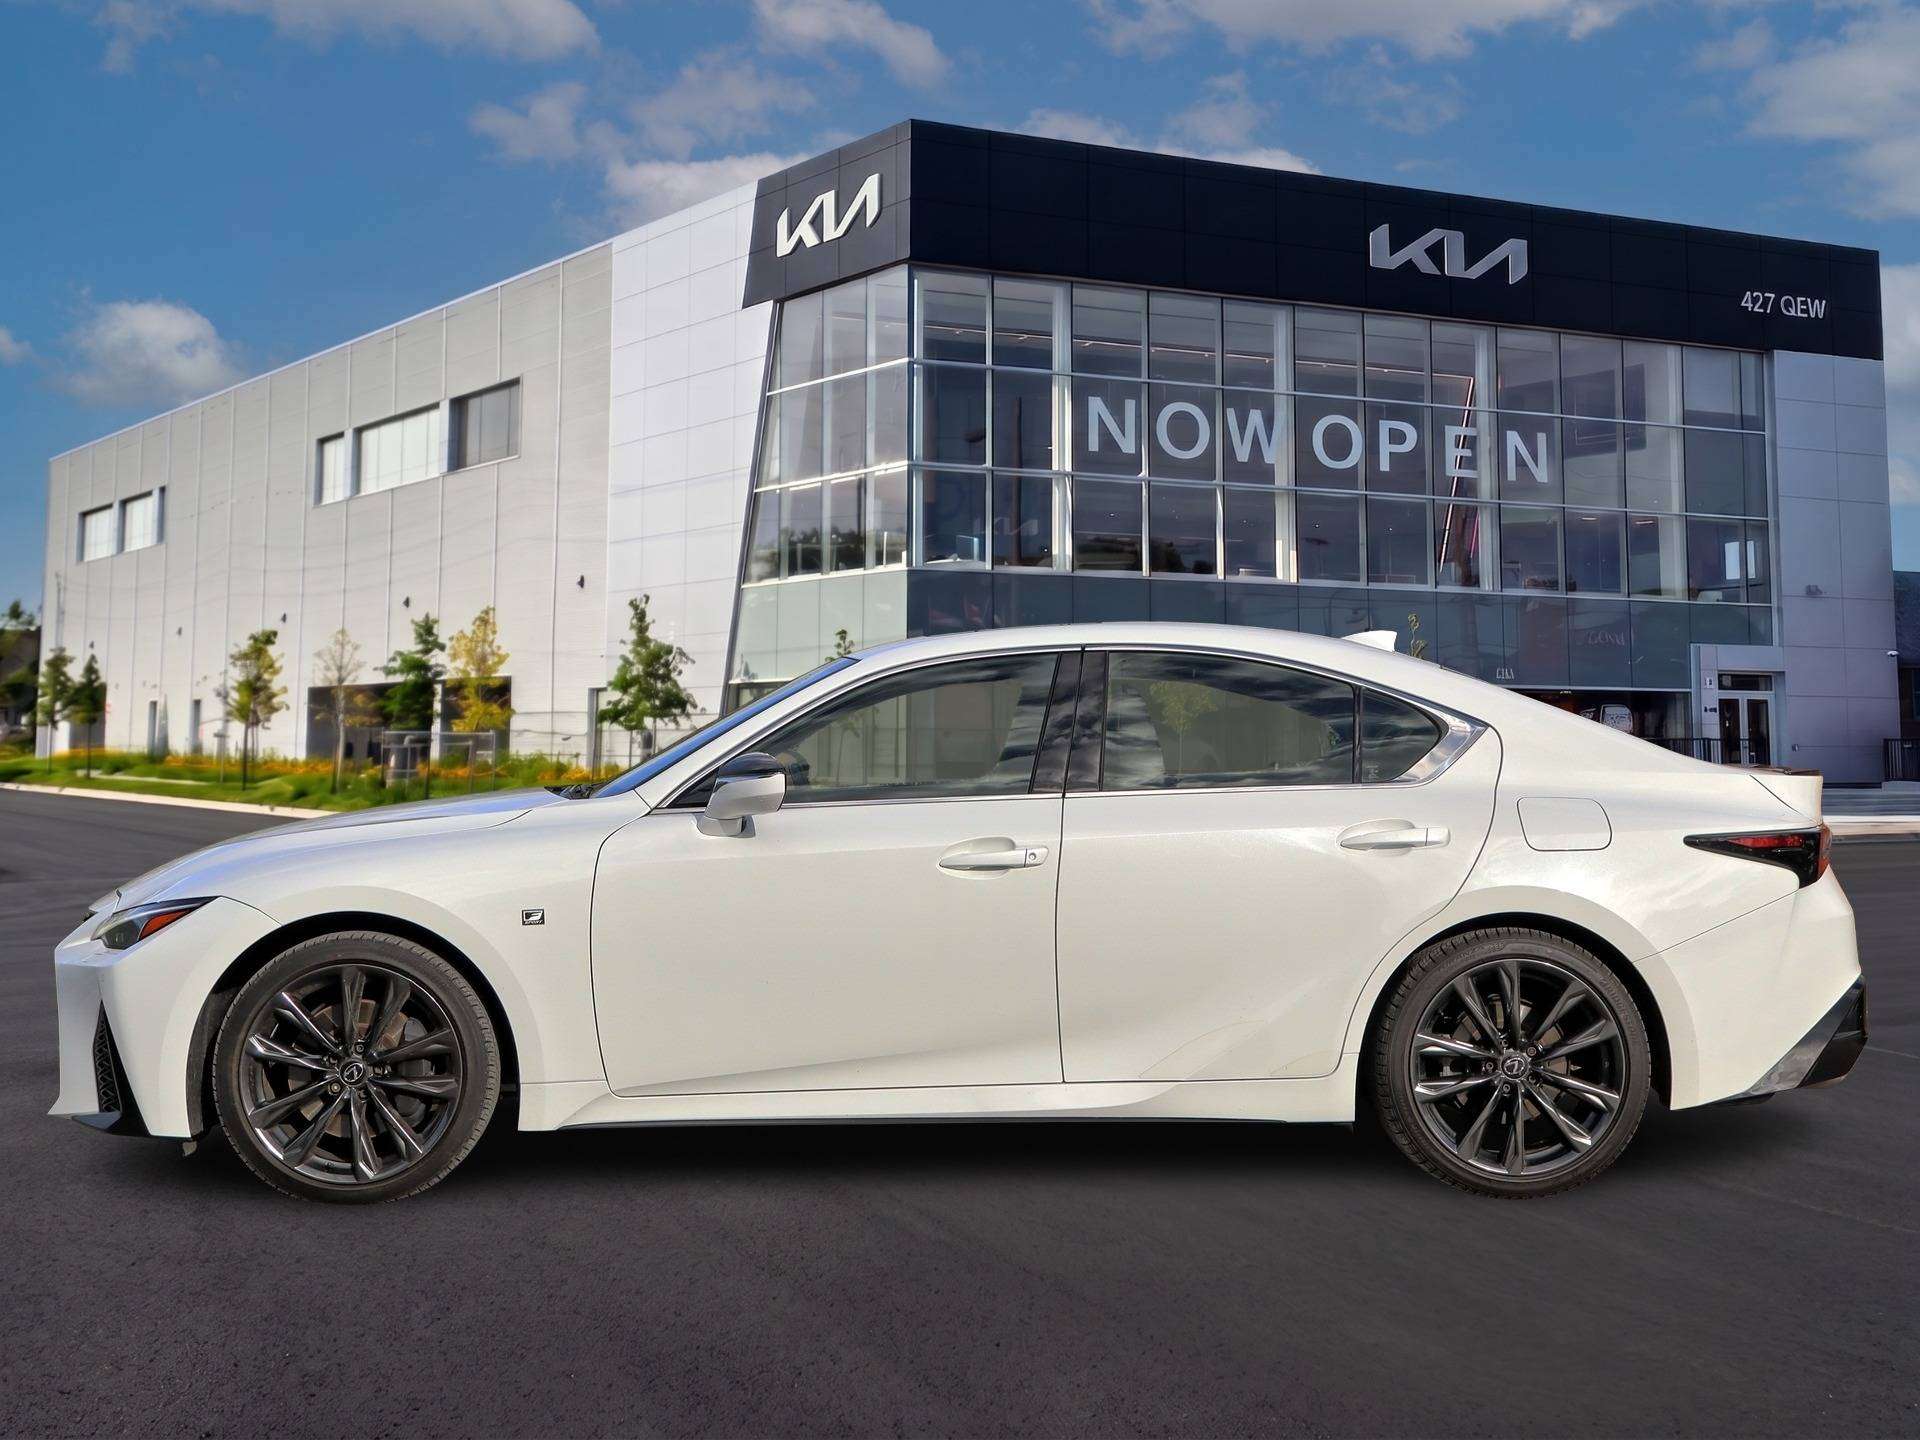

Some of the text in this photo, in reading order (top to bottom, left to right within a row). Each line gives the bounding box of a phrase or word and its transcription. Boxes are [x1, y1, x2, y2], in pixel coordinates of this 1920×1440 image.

[777, 173, 880, 257] KIA
[1369, 224, 1528, 284] KIA
[1740, 291, 1826, 318] 427 QEW
[1088, 396, 1548, 483] NOW OPEN
